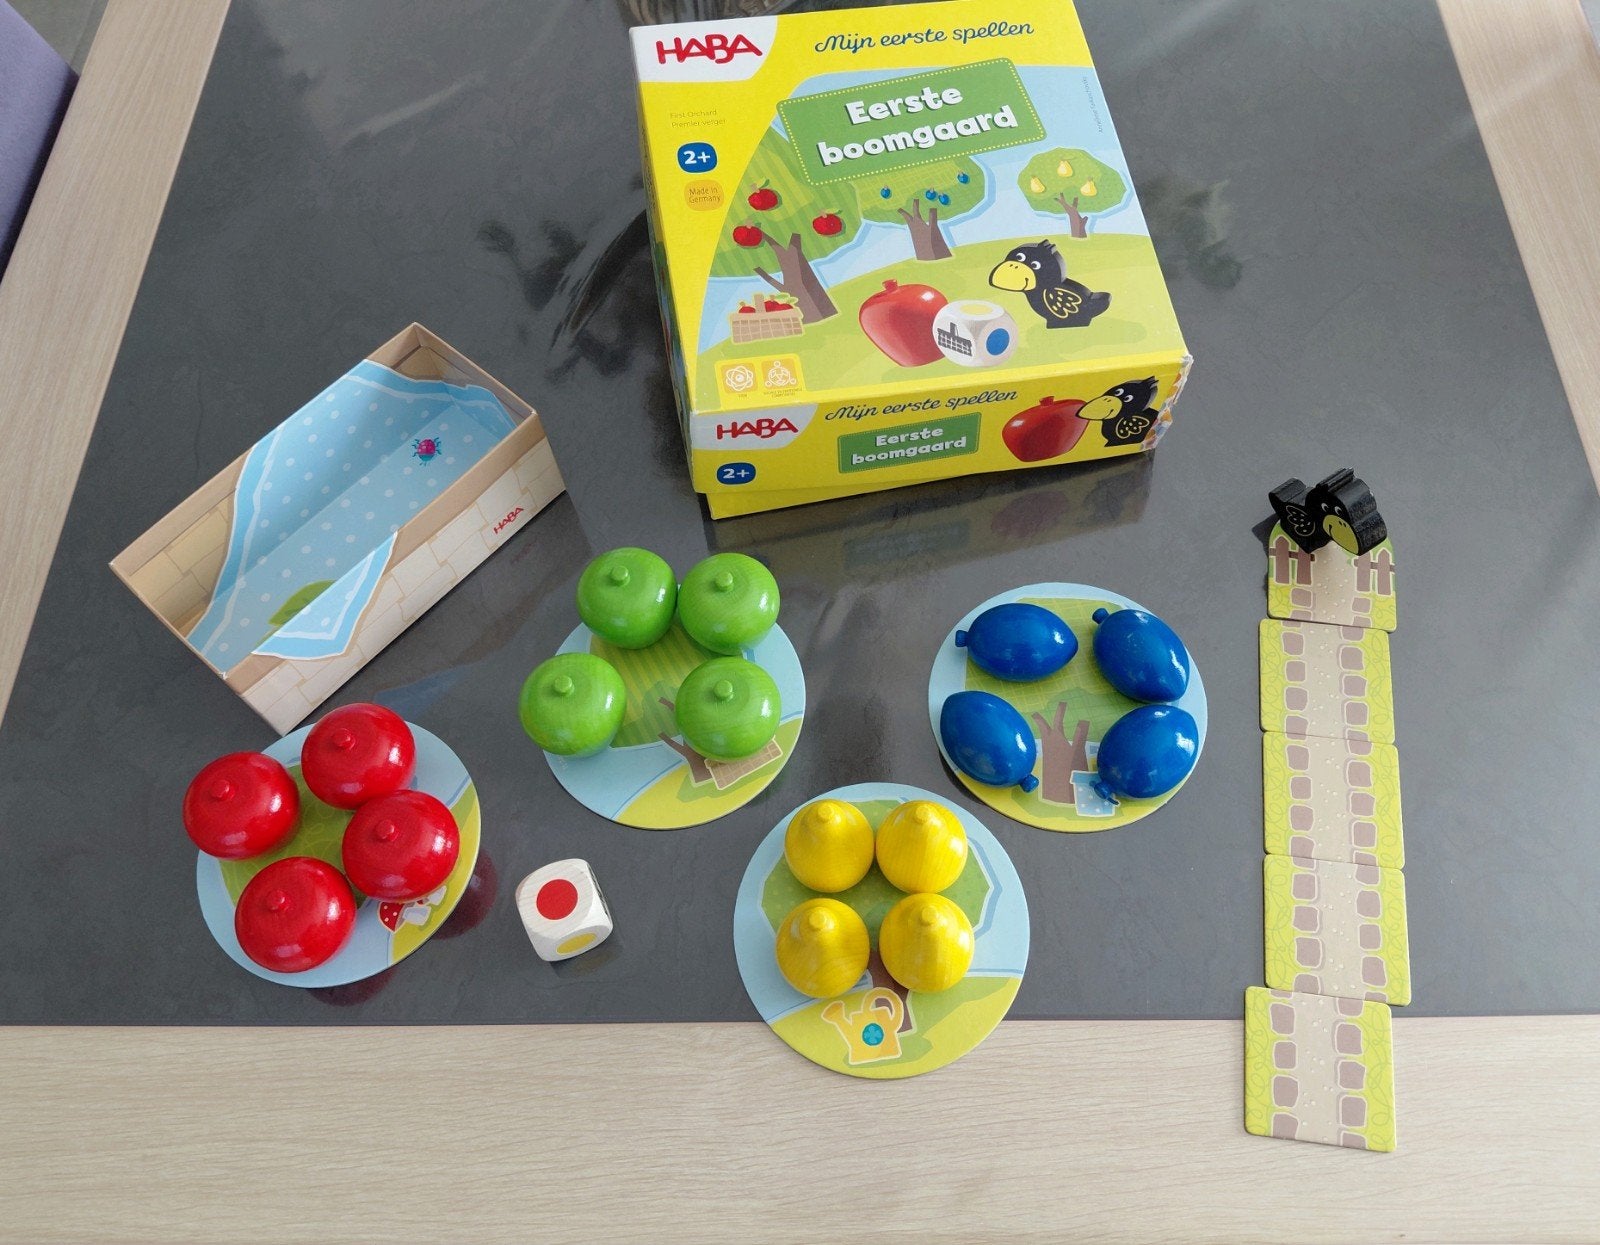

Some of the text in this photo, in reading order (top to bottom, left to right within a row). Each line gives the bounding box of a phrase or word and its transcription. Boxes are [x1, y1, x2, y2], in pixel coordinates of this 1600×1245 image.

[656, 34, 763, 64] HABA
[814, 21, 1035, 54] Mijn eerste spellen
[687, 109, 718, 118] Orchard
[845, 86, 963, 125] Eerste
[816, 104, 1019, 166] boomgaard
[683, 150, 711, 165] 2+
[689, 187, 709, 196] Made
[689, 194, 721, 204] Germany
[825, 389, 1018, 421] Mijn eerste spellen
[716, 418, 799, 440] HABA
[875, 426, 944, 448] Eerste
[851, 436, 967, 466] boomgaard
[722, 468, 750, 480] 2+
[493, 507, 524, 535] HABA
